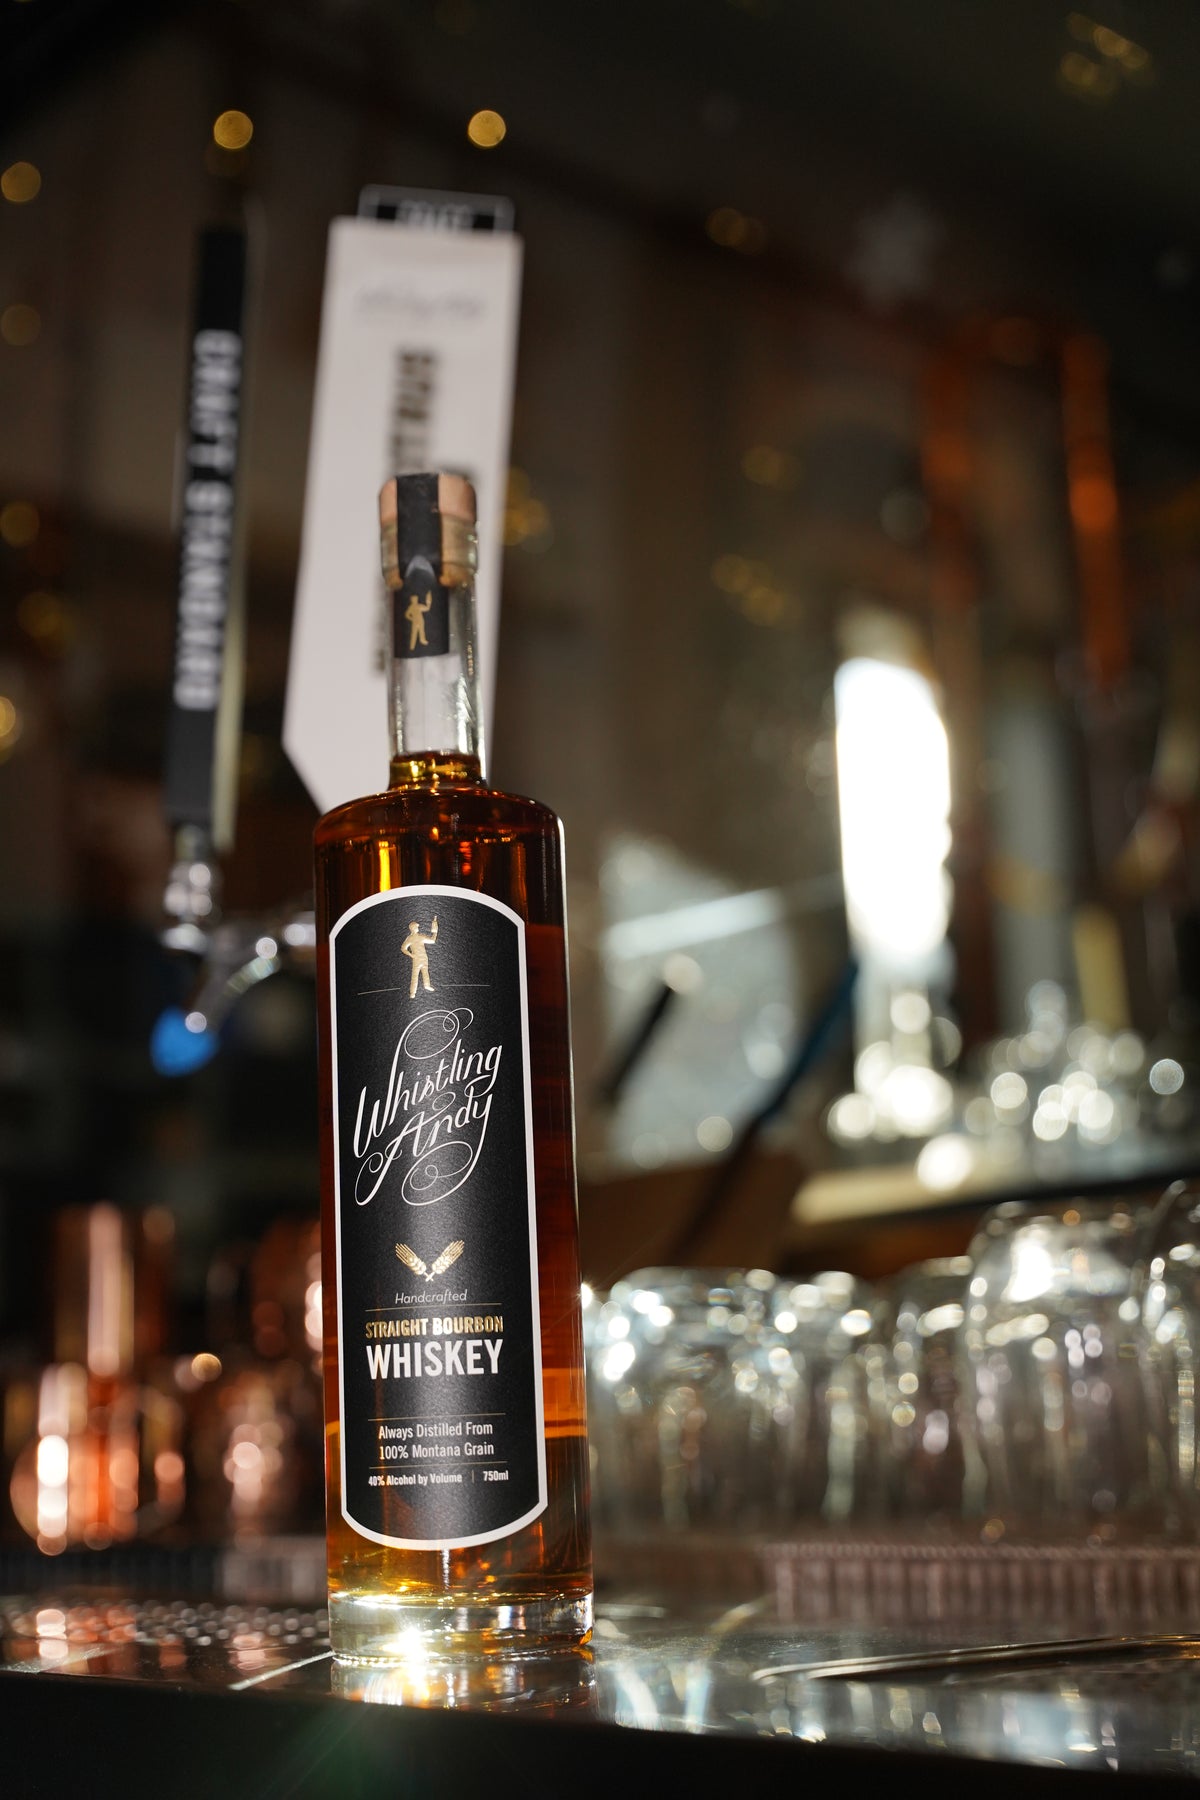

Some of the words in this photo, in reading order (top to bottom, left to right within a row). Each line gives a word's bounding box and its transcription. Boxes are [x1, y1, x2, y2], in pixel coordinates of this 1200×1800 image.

[354, 1007, 502, 1158] Whistling
[355, 1087, 493, 1206] Andy
[395, 1289, 468, 1304] Handcrafted
[365, 1318, 428, 1339] STRAIGHT
[432, 1315, 504, 1335] BOURBON
[366, 1339, 503, 1380] WHISKEY
[379, 1425, 413, 1440] Always
[416, 1422, 462, 1437] Distilled
[466, 1421, 493, 1435] From
[380, 1445, 409, 1460] 100%
[412, 1444, 460, 1458] Montana
[464, 1441, 494, 1456] Grain
[368, 1475, 385, 1486] 40%
[386, 1474, 416, 1486] Alcohol
[418, 1473, 428, 1486] by
[430, 1472, 462, 1483] Volume
[483, 1470, 509, 1482] 750ml
